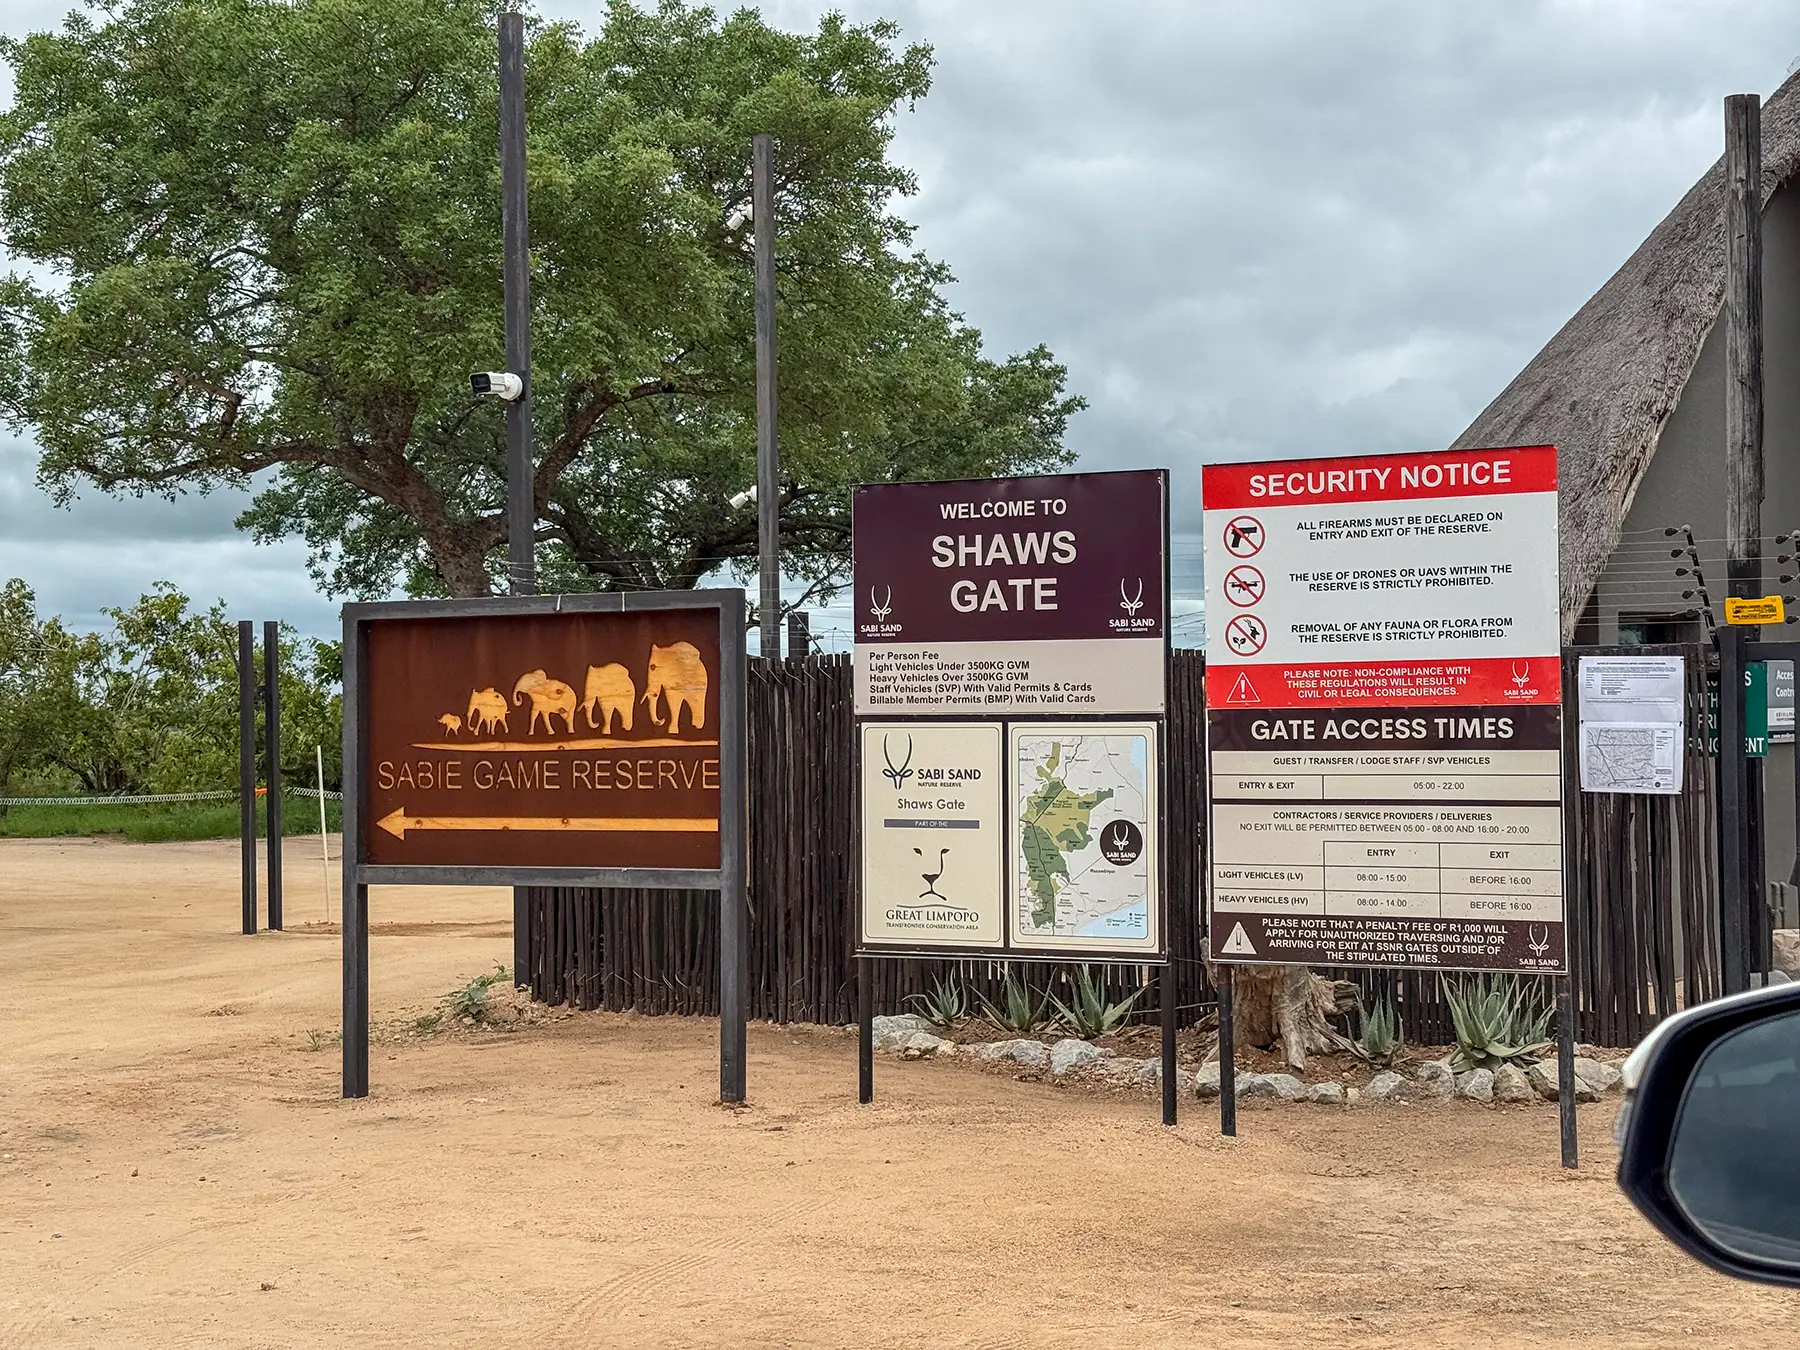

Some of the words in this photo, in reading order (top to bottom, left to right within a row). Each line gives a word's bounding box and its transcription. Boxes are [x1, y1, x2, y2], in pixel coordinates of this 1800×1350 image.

[1250, 469, 1391, 496] SECURITY
[1401, 461, 1511, 487] NOTICE
[940, 501, 1035, 518] WELCOME
[1041, 499, 1066, 514] TO
[1297, 522, 1316, 530] ALL
[1319, 519, 1372, 528] FIREARMS
[1375, 517, 1404, 526] MUST
[1408, 516, 1422, 525] BE
[1425, 513, 1484, 523] DECLARED
[1487, 512, 1502, 520] ON
[1310, 531, 1344, 540] ENTRY
[1346, 530, 1368, 538] AND
[1371, 528, 1394, 537] EXIT
[1397, 527, 1411, 536] OF
[1414, 526, 1435, 535] THE
[1438, 524, 1492, 534] RESERVE.
[932, 532, 1076, 566] SHAWS
[1289, 573, 1309, 581] THE
[1312, 572, 1333, 581] USE
[1336, 571, 1350, 580] OF
[1353, 570, 1397, 579] DRONES
[1400, 569, 1416, 577] OR
[1418, 567, 1447, 576] UAVS
[1449, 566, 1487, 575] WITHIN
[1490, 564, 1512, 573] THE
[1309, 582, 1357, 591] RESERVE
[1360, 581, 1370, 590] IS
[1373, 580, 1422, 589] STRICTLY
[1426, 577, 1494, 586] PROHIBITED.
[951, 579, 1058, 611] GATE
[1292, 624, 1341, 632] REMOVAL
[1344, 623, 1358, 631] OF
[1360, 622, 1382, 630] ANY
[1385, 621, 1420, 629] FAUNA
[1423, 620, 1439, 628] OR
[1442, 619, 1478, 628] FLORA
[1481, 618, 1512, 626] FROM
[1298, 635, 1318, 643] THE
[1321, 633, 1370, 642] RESERVE
[1373, 632, 1382, 641] IS
[1385, 631, 1435, 640] STRICTLY
[1438, 629, 1507, 638] PROHIBITED.
[870, 652, 885, 660] Per
[888, 652, 920, 660] Person
[923, 651, 939, 660] Fee
[870, 663, 892, 673] Light
[937, 662, 965, 670] Under
[968, 661, 1004, 670] 3500KG
[1007, 661, 1029, 671] GVM
[1284, 670, 1321, 678] PLEASE
[1355, 667, 1443, 676] NON-COMPLIANCE
[870, 674, 897, 685] Heavy
[900, 674, 939, 682] Vehicles
[942, 673, 964, 681] Over
[967, 672, 1003, 681] 3500KG
[1006, 672, 1028, 681] GVM
[1286, 680, 1318, 688] THESE
[1320, 679, 1388, 687] REGULATIONS
[1416, 677, 1454, 686] RESULT
[870, 684, 891, 693] Staff
[893, 684, 932, 693] Vehicles
[935, 684, 960, 694] (SVP)
[964, 684, 984, 692] With
[988, 684, 1011, 692] Valid
[1014, 683, 1050, 692] Permits
[1054, 683, 1060, 692] &
[1064, 683, 1092, 691] Cards
[1298, 690, 1322, 698] CIVIL
[1324, 689, 1338, 698] OR
[1340, 689, 1372, 697] LEGAL
[1375, 687, 1459, 696] CONSEQUENCES.
[870, 696, 903, 704] Billable
[907, 695, 943, 704] Member
[946, 695, 981, 703] Permits
[985, 695, 1012, 705] (BMP)
[1016, 695, 1037, 703] With
[1040, 694, 1064, 703] Valid
[1067, 694, 1095, 702] Cards
[1251, 720, 1315, 739] GATE
[1323, 719, 1427, 739] ACCESS
[1434, 718, 1514, 738] TIMES
[379, 762, 462, 789] SABIE
[474, 761, 559, 789] GAME
[573, 760, 719, 789] RESERVE
[918, 769, 944, 779] SABI
[948, 769, 981, 780] SAND
[898, 799, 933, 809] Shaws
[937, 799, 965, 809] Gate
[1287, 873, 1303, 881] (LV)
[1291, 897, 1308, 906] (HV)
[886, 908, 923, 920] GREAT
[927, 908, 979, 922] LIMPOPO
[1263, 918, 1298, 927] PLEASE
[1302, 920, 1326, 928] NOTE
[1329, 920, 1354, 928] THAT
[1366, 921, 1409, 930] PENALTY
[1413, 922, 1430, 931] FEE
[1434, 923, 1447, 931] OF
[1450, 924, 1481, 933] R1,000
[1484, 925, 1508, 933] WILL
[1266, 929, 1296, 938] APPLY
[1299, 930, 1318, 938] FOR
[1320, 931, 1394, 940] UNAUTHORIZED
[1397, 933, 1460, 942] TRAVERSING
[1269, 940, 1314, 948] ARRIVING
[1317, 941, 1335, 950] FOR
[1339, 941, 1359, 950] EXIT
[1362, 942, 1374, 951] AT
[1377, 942, 1403, 951] SSNR
[1406, 944, 1438, 952] GATES
[1441, 945, 1486, 954] OUTSIDE
[1487, 946, 1500, 955] OF
[1326, 951, 1344, 960] THE
[1347, 952, 1406, 962] STIPULATED
[1408, 954, 1441, 963] TIMES.
